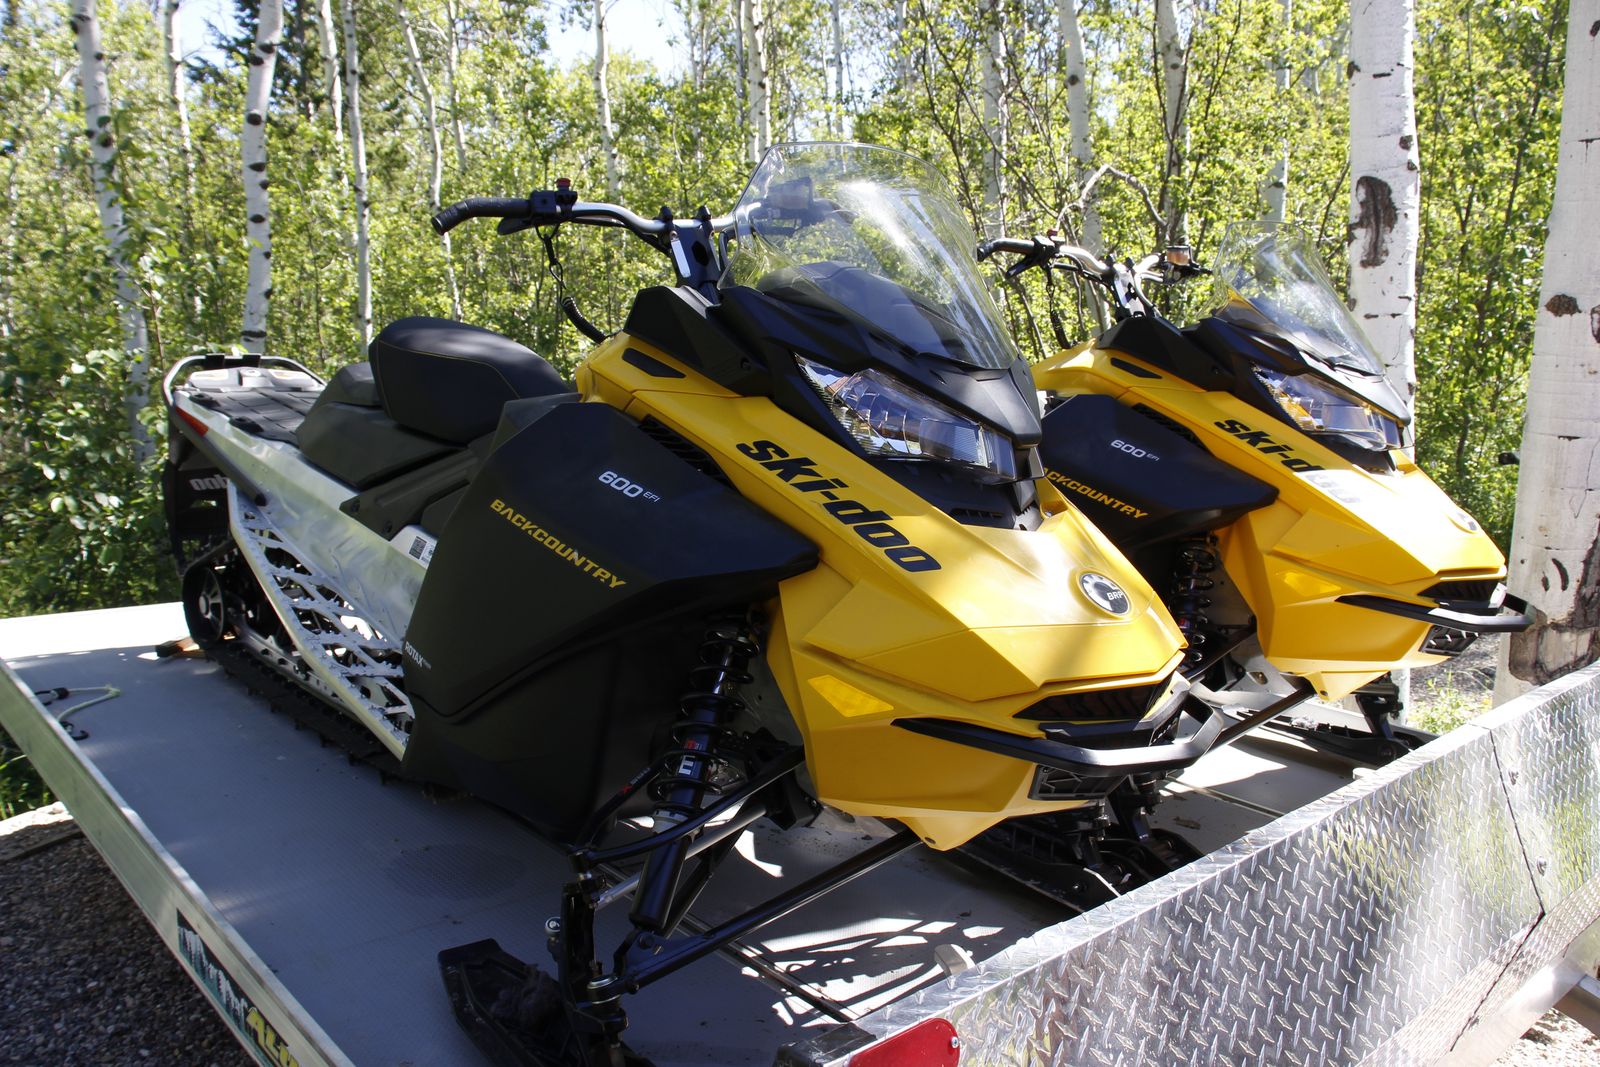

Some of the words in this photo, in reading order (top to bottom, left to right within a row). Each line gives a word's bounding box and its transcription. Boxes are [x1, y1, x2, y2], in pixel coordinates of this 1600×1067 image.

[1111, 439, 1146, 458] 600
[1147, 453, 1160, 461] EFI
[598, 470, 643, 498] 600
[643, 491, 660, 502] EFI
[1043, 467, 1149, 519] CKCOUNTRY
[490, 499, 627, 589] BACKCOUNTRY
[1107, 591, 1124, 601] BRP
